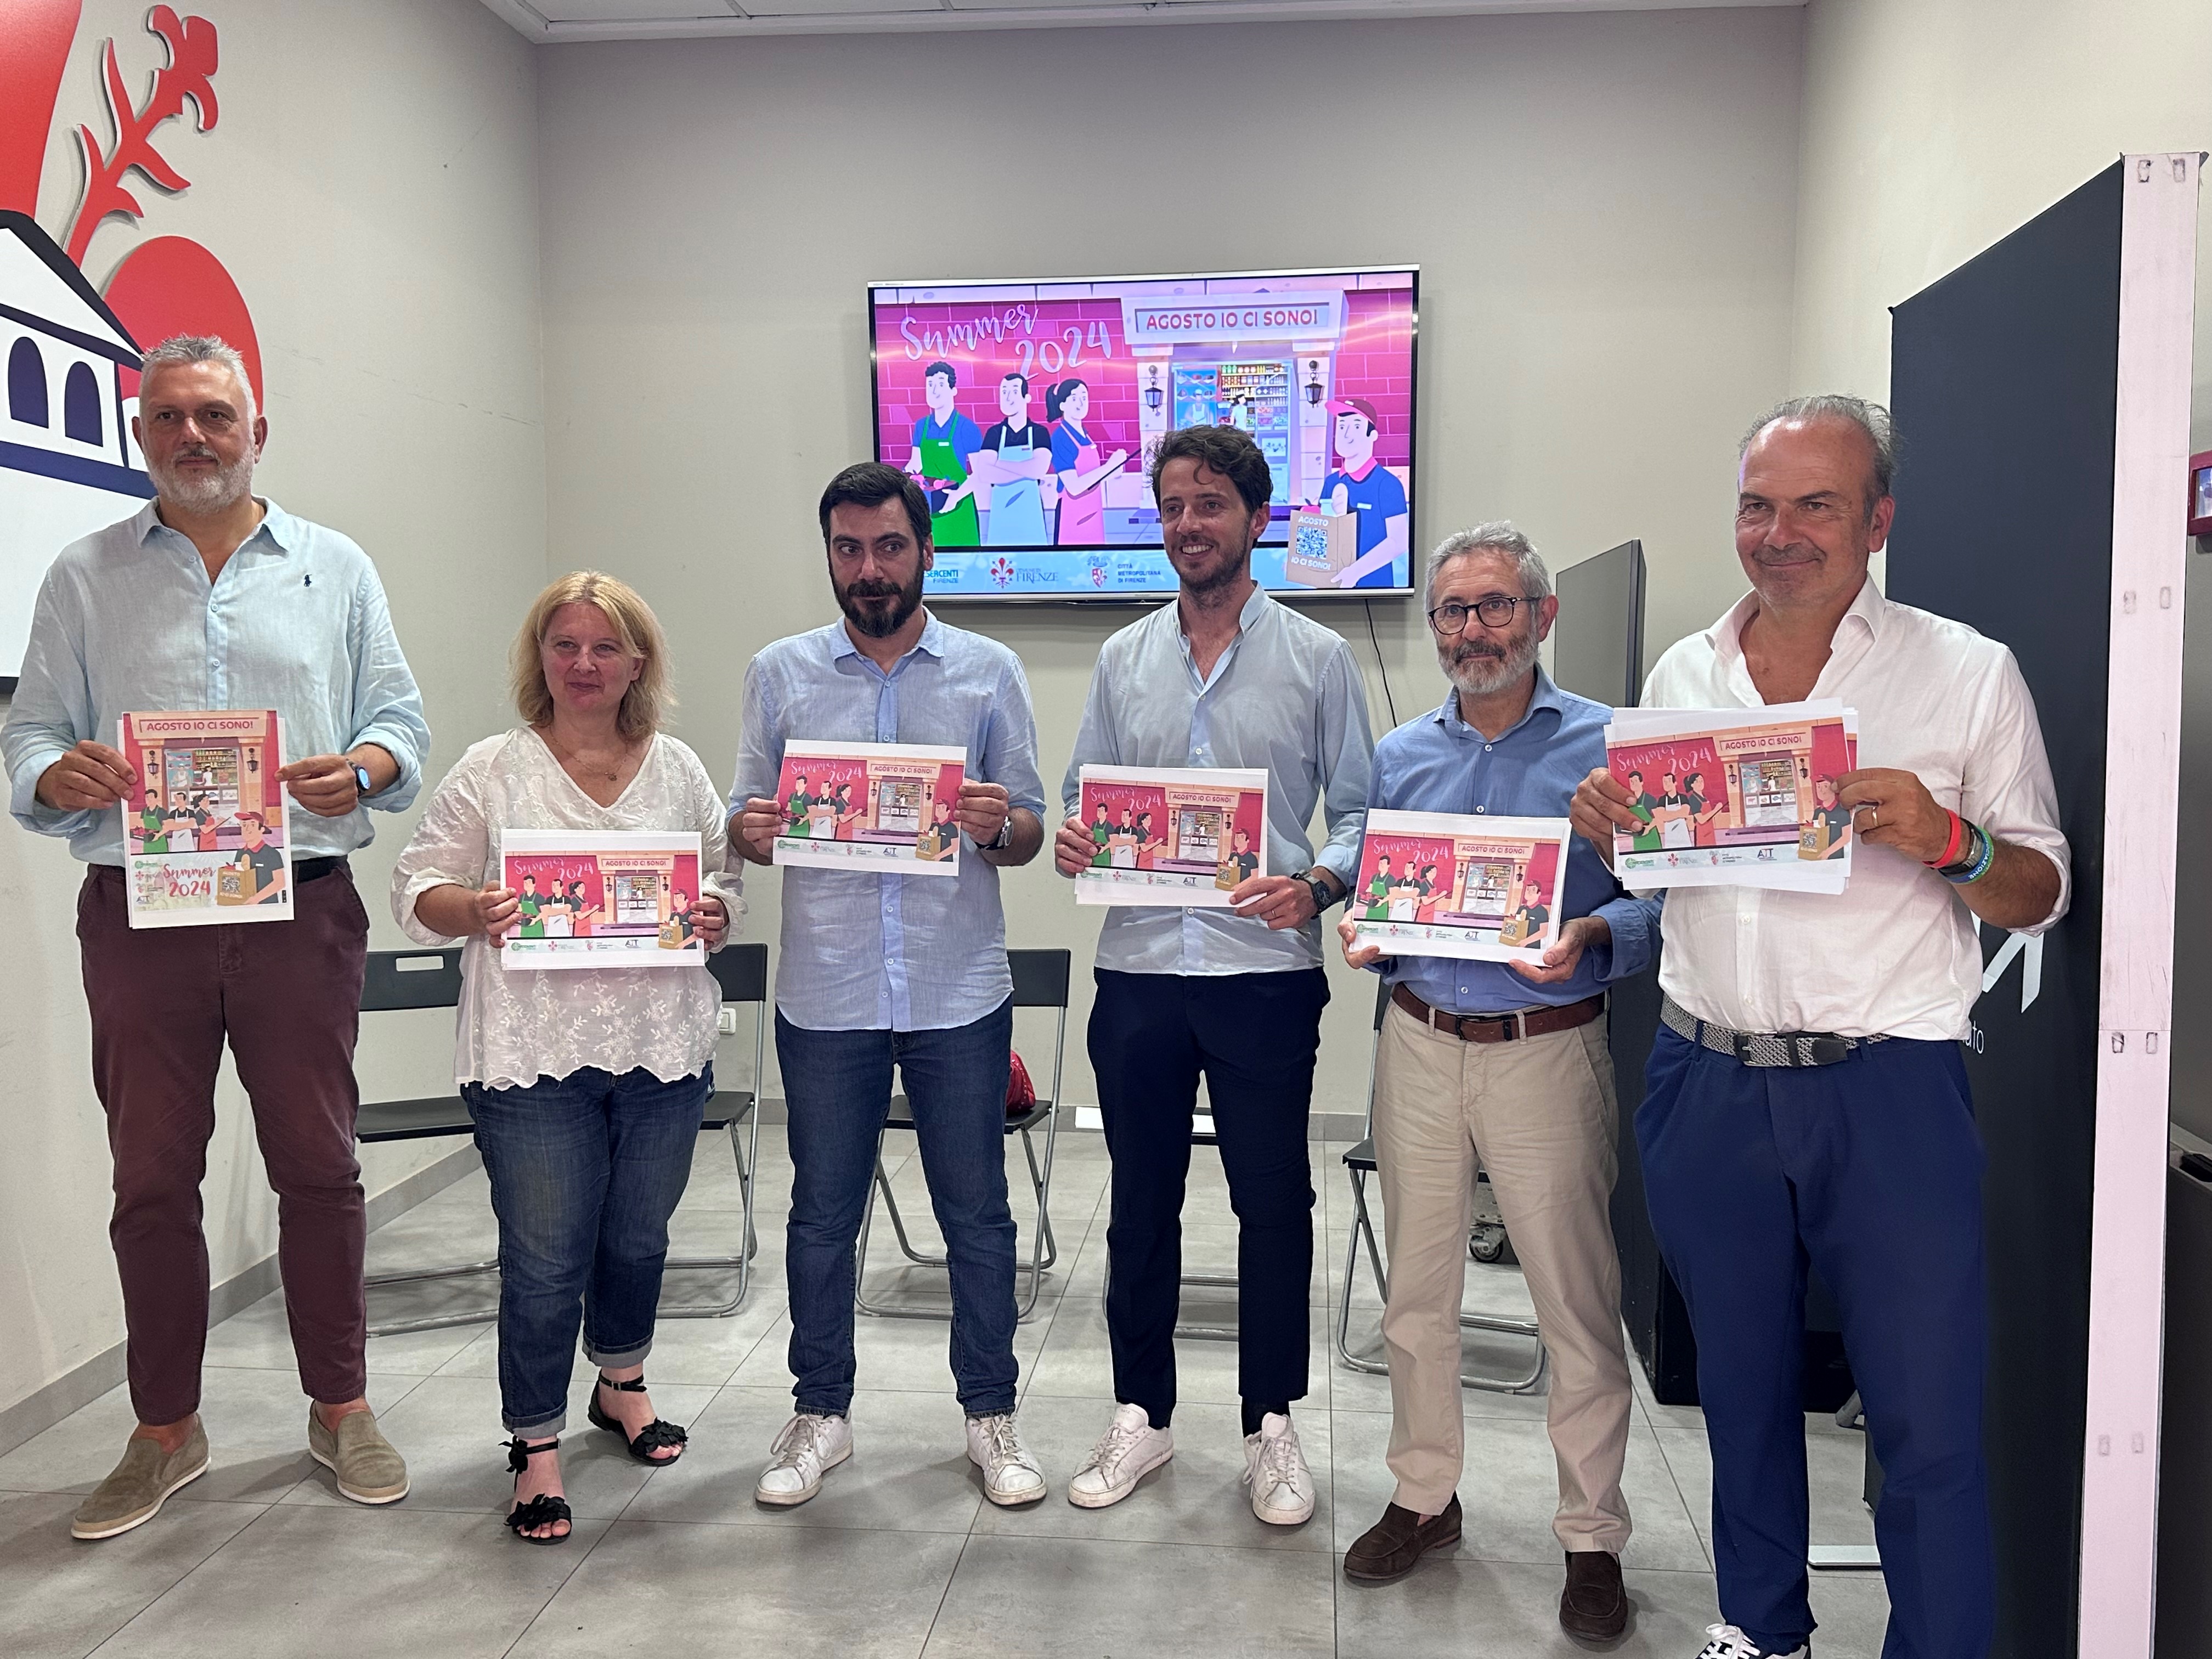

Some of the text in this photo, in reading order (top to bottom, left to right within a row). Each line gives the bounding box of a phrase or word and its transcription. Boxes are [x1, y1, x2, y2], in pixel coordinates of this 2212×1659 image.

[1146, 313, 1216, 330] AGOSTO
[1221, 312, 1238, 328] IO
[1243, 311, 1258, 328] CI
[900, 303, 1039, 360] Summer
[1015, 320, 1112, 381] 2024
[1298, 516, 1329, 527] AGOSTO
[1291, 556, 1299, 564] IO
[1307, 560, 1331, 571] SONO!
[925, 569, 958, 578] SERCENTI
[1016, 572, 1058, 584] FIRENZE
[146, 723, 191, 731] AGOSTO
[194, 721, 205, 730] IO
[207, 721, 217, 730] CI
[1725, 740, 1756, 750] AGOSTO
[1758, 739, 1766, 747] IO
[1768, 738, 1775, 746] CI
[1616, 743, 1677, 772] Summer
[1668, 747, 1712, 775] 2024
[791, 760, 837, 775] Summer
[828, 766, 862, 783] 2024
[1090, 787, 1135, 802] Summer
[1128, 794, 1161, 812] 2024
[1373, 838, 1421, 855] Summer
[1413, 846, 1448, 865] 2024
[163, 863, 216, 879] Summer
[514, 856, 565, 875] Summer
[557, 862, 594, 881] 2024
[169, 880, 211, 897] 2024
